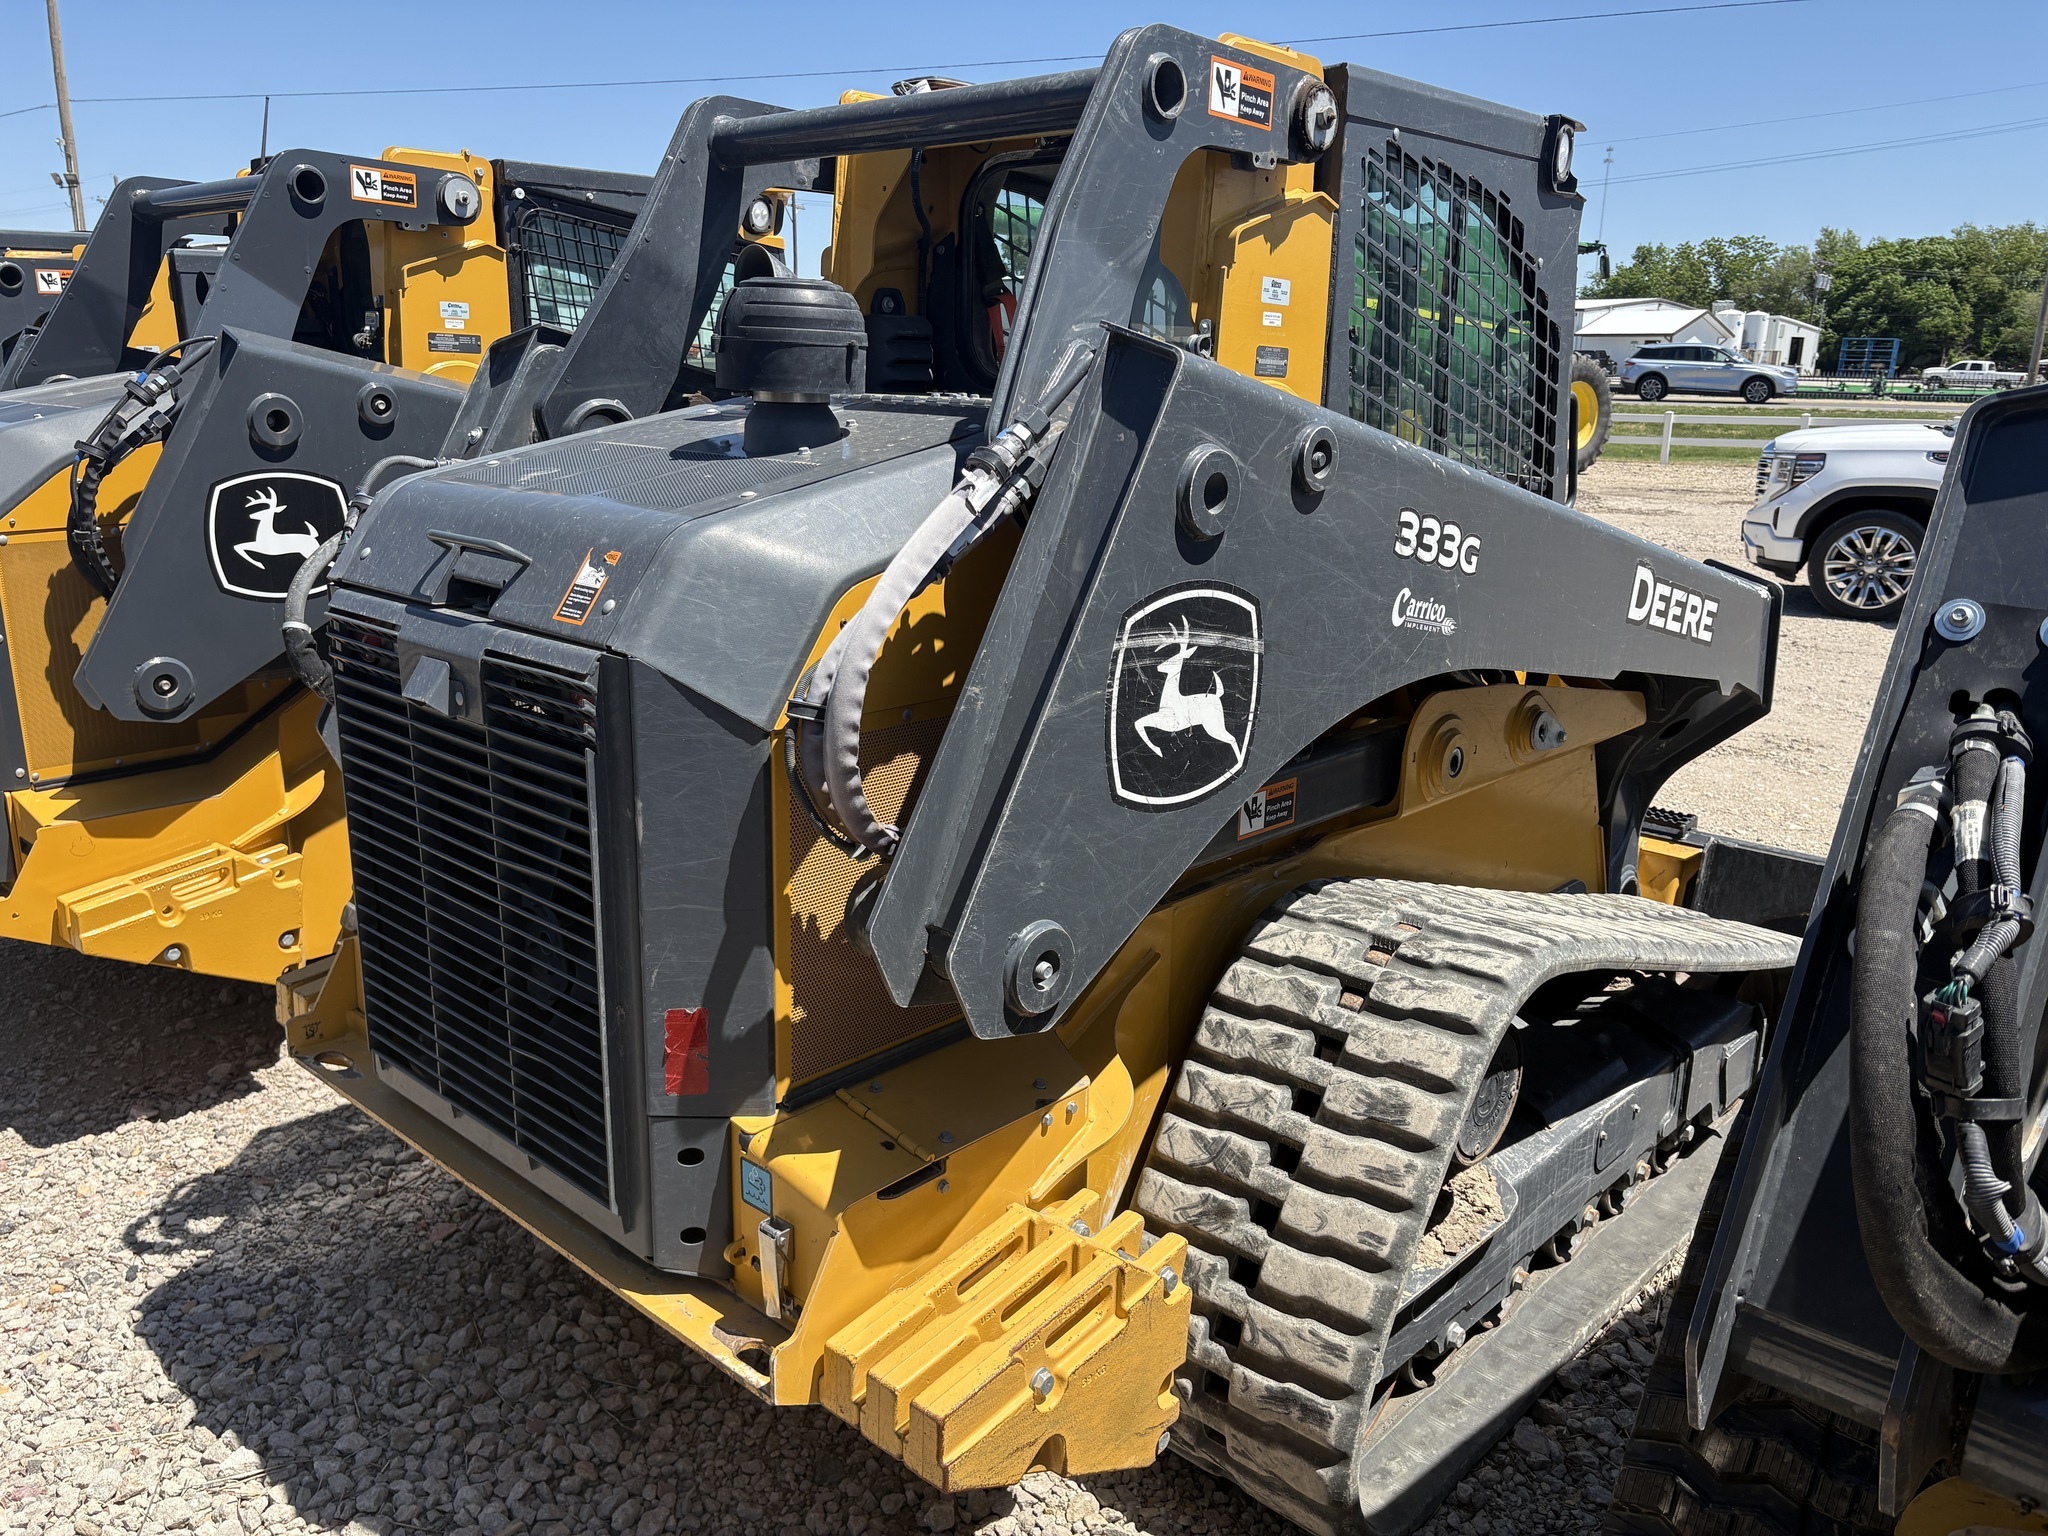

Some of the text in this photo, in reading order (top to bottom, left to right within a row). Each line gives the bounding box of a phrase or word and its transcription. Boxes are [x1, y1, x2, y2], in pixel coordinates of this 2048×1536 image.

[1248, 73, 1272, 88] WARNING
[1241, 91, 1269, 108] Pinch Area
[1240, 103, 1265, 119] Keep Away
[388, 174, 413, 182] WARNING
[383, 184, 412, 194] Pinch Area
[396, 193, 409, 201] Away
[1394, 508, 1481, 575] 333G
[1391, 587, 1446, 628] Carrico
[1627, 564, 1719, 642] DEERE
[1404, 621, 1441, 633] IMPLEMENT
[1266, 799, 1292, 812] Pinch Area
[1266, 810, 1288, 821] Keep Away
[137, 873, 151, 882] USA
[152, 883, 166, 892] USA
[936, 1281, 954, 1297] USA
[980, 1308, 997, 1325] USA
[1024, 1335, 1042, 1352] USA
